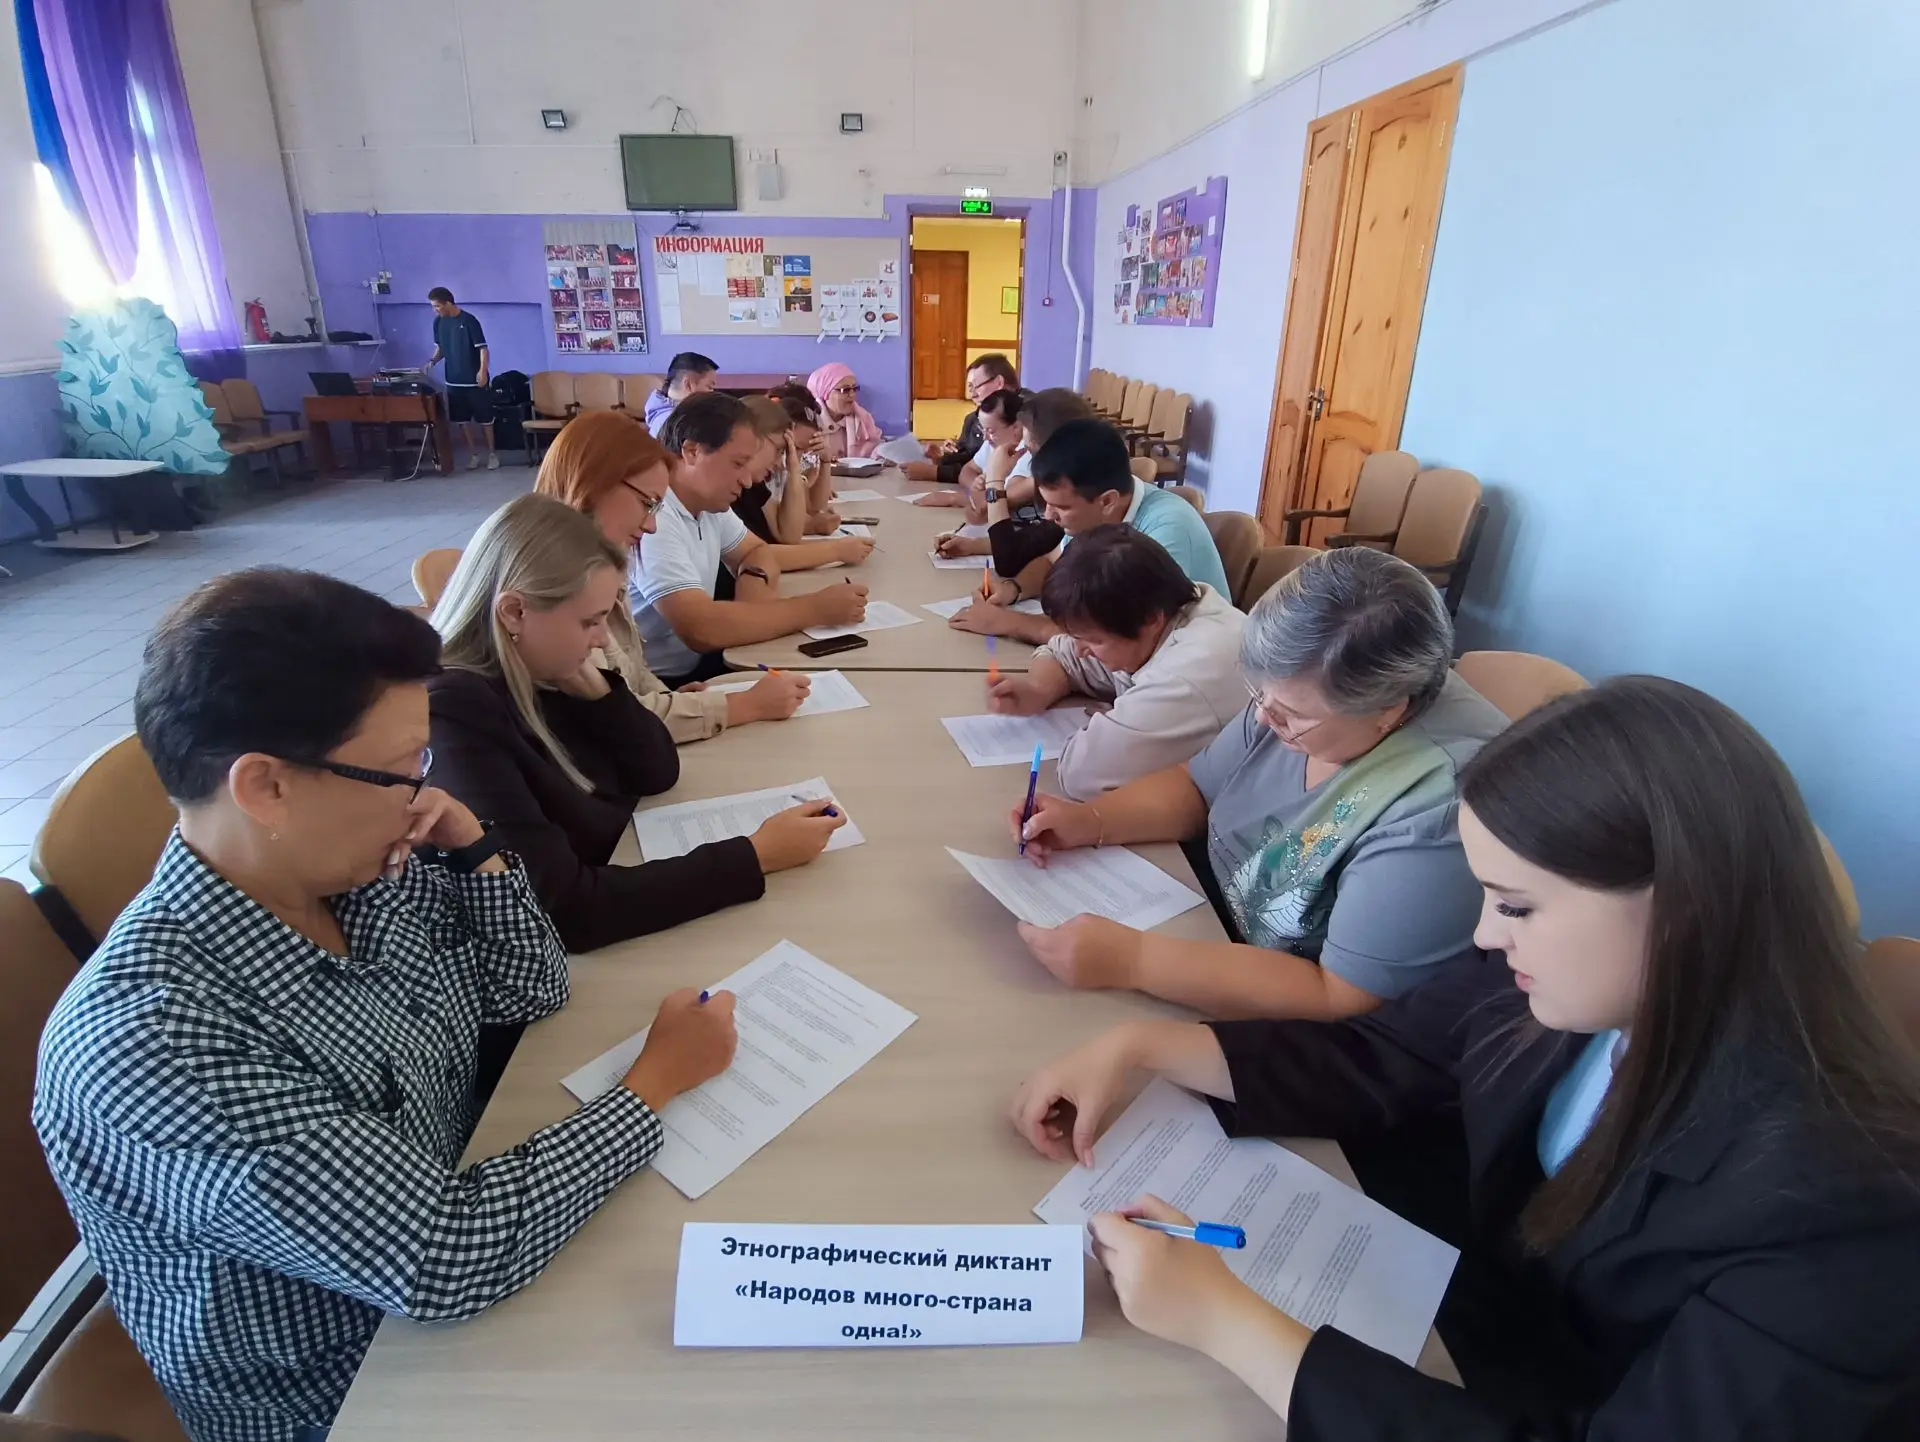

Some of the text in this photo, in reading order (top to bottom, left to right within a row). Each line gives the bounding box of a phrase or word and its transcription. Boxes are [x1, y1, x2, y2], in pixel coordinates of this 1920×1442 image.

[655, 236, 764, 254] ИНФОРМАЦИЯ
[720, 1236, 1052, 1272] Этнографический диктант
[735, 1280, 1032, 1315] «Народов много-страна
[841, 1323, 922, 1341] одна!»
